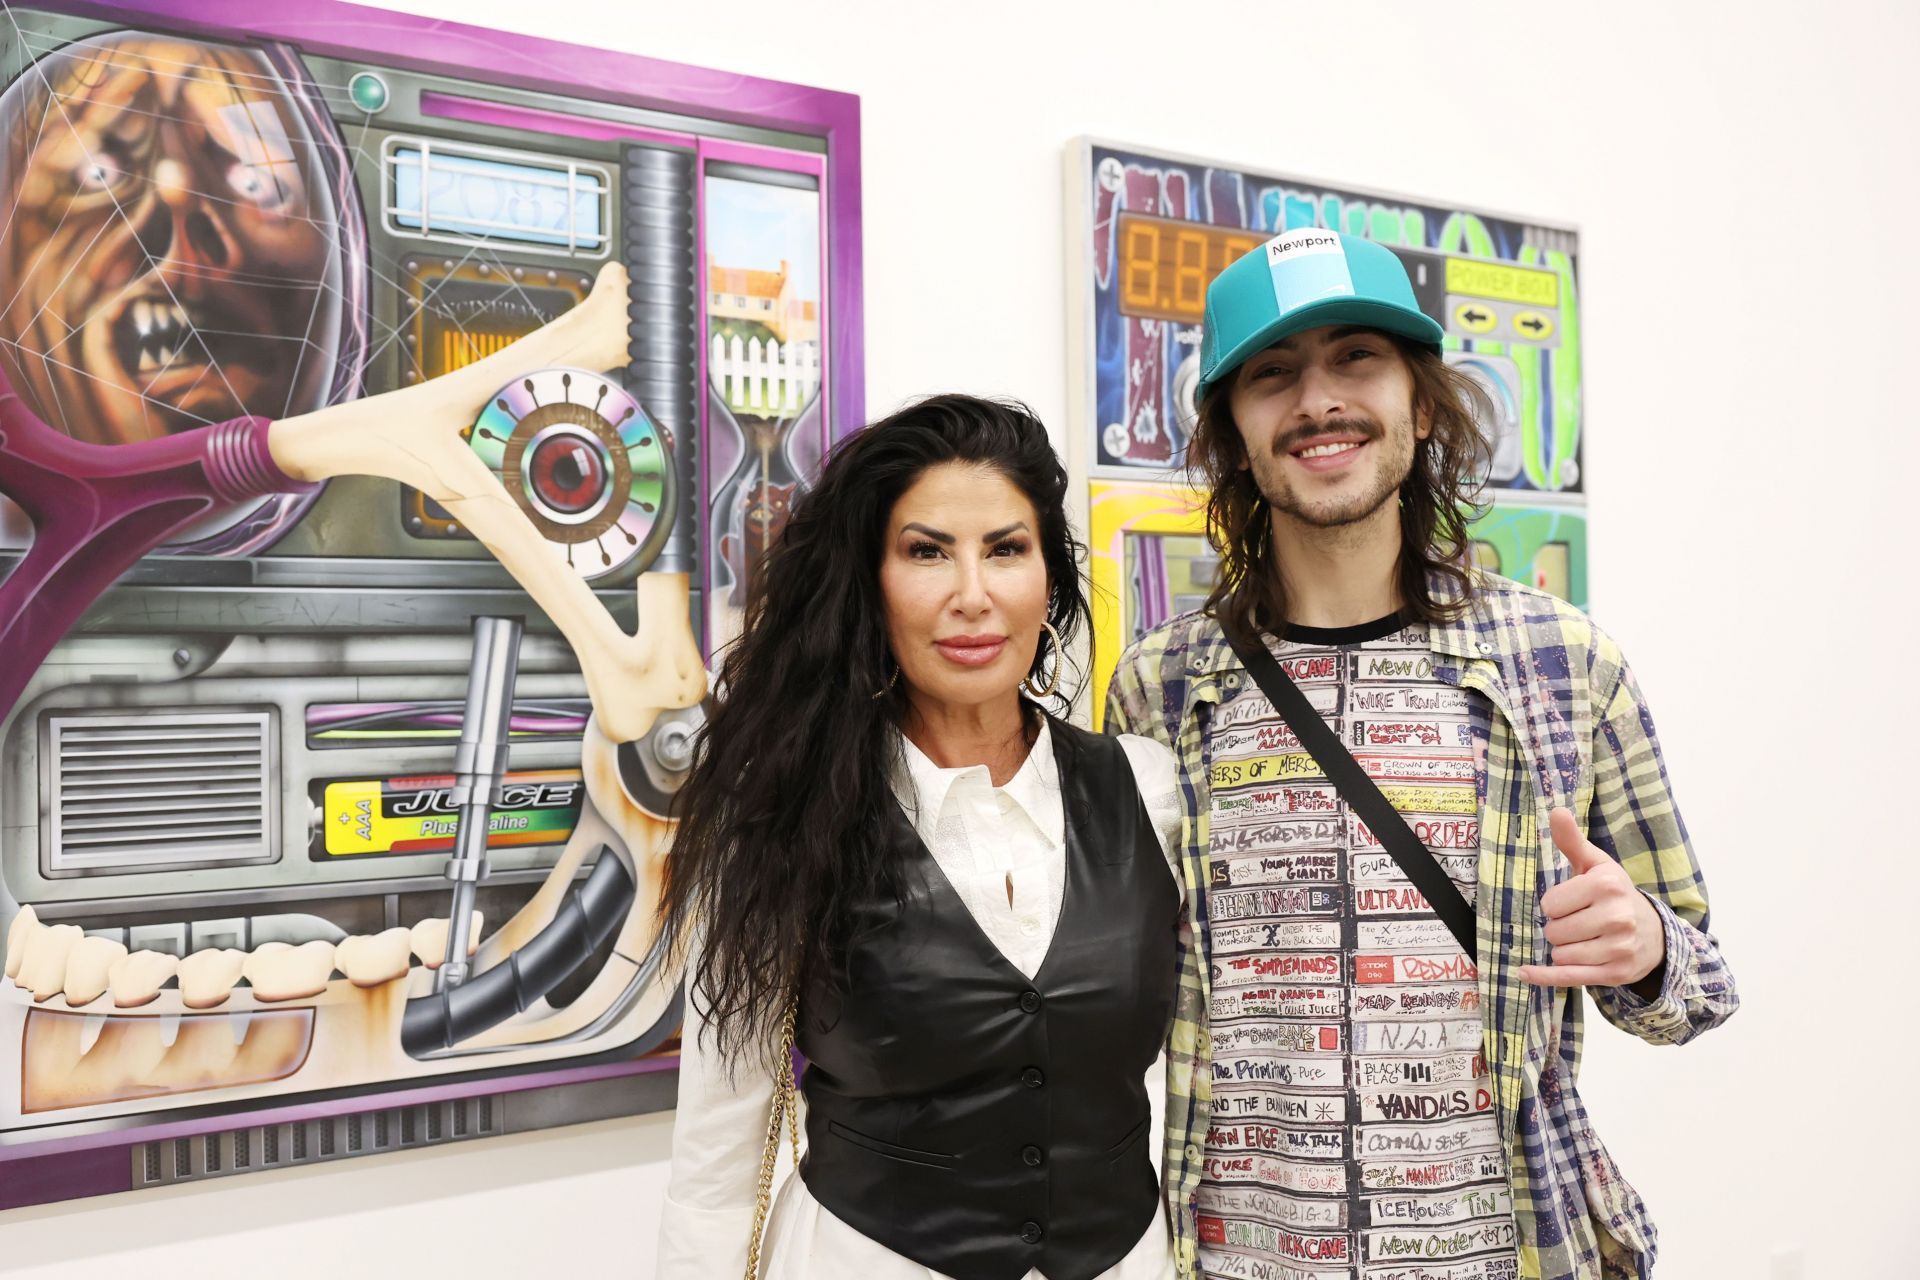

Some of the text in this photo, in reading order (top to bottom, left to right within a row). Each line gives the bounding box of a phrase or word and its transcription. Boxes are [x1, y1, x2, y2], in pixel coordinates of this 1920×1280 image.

[1272, 236, 1337, 256] Newport
[1451, 261, 1510, 291] POWER
[1368, 658, 1414, 676] New
[1355, 691, 1395, 711] WIRE
[1354, 723, 1363, 746] SONY
[1369, 733, 1412, 745] BEAT
[1249, 761, 1267, 778] OF
[1383, 760, 1422, 769] CROWN
[1427, 761, 1441, 770] OF
[393, 782, 579, 815] JUCE
[356, 799, 372, 840] AAA
[420, 819, 457, 836] Plus
[1414, 820, 1480, 849] ORDER
[1260, 857, 1294, 872] YOUNG
[1286, 867, 1336, 881] GIANTS
[1261, 924, 1281, 948] X
[1282, 924, 1304, 936] UNDER
[1315, 930, 1337, 945] SUN
[1374, 936, 1396, 946] THE
[1241, 988, 1278, 1001] AGENT
[1279, 988, 1326, 1001] ORANGE
[1357, 995, 1396, 1011] DEAD
[1308, 1004, 1337, 1015] JUICE
[1278, 1024, 1316, 1041] RANK
[1211, 1061, 1233, 1081] The
[1299, 1066, 1326, 1081] Pure
[1364, 1062, 1403, 1075] BLACK
[1366, 1072, 1399, 1085] FLAG
[1211, 1096, 1230, 1113] AND
[1233, 1096, 1260, 1115] THE
[1375, 1090, 1470, 1120] VANDALS
[1244, 1126, 1279, 1149] EDGE
[1309, 1133, 1342, 1148] TALK
[1367, 1131, 1471, 1152] COMMON SENSE
[1210, 1157, 1253, 1180] CURE
[1214, 1194, 1240, 1210] THE
[1376, 1198, 1458, 1222] ICEHOUSE
[1224, 1221, 1253, 1247] GUN
[1277, 1230, 1307, 1259] NICK
[1304, 1235, 1348, 1261] CAVE
[1378, 1234, 1423, 1256] New
[1425, 1229, 1481, 1257] Order
